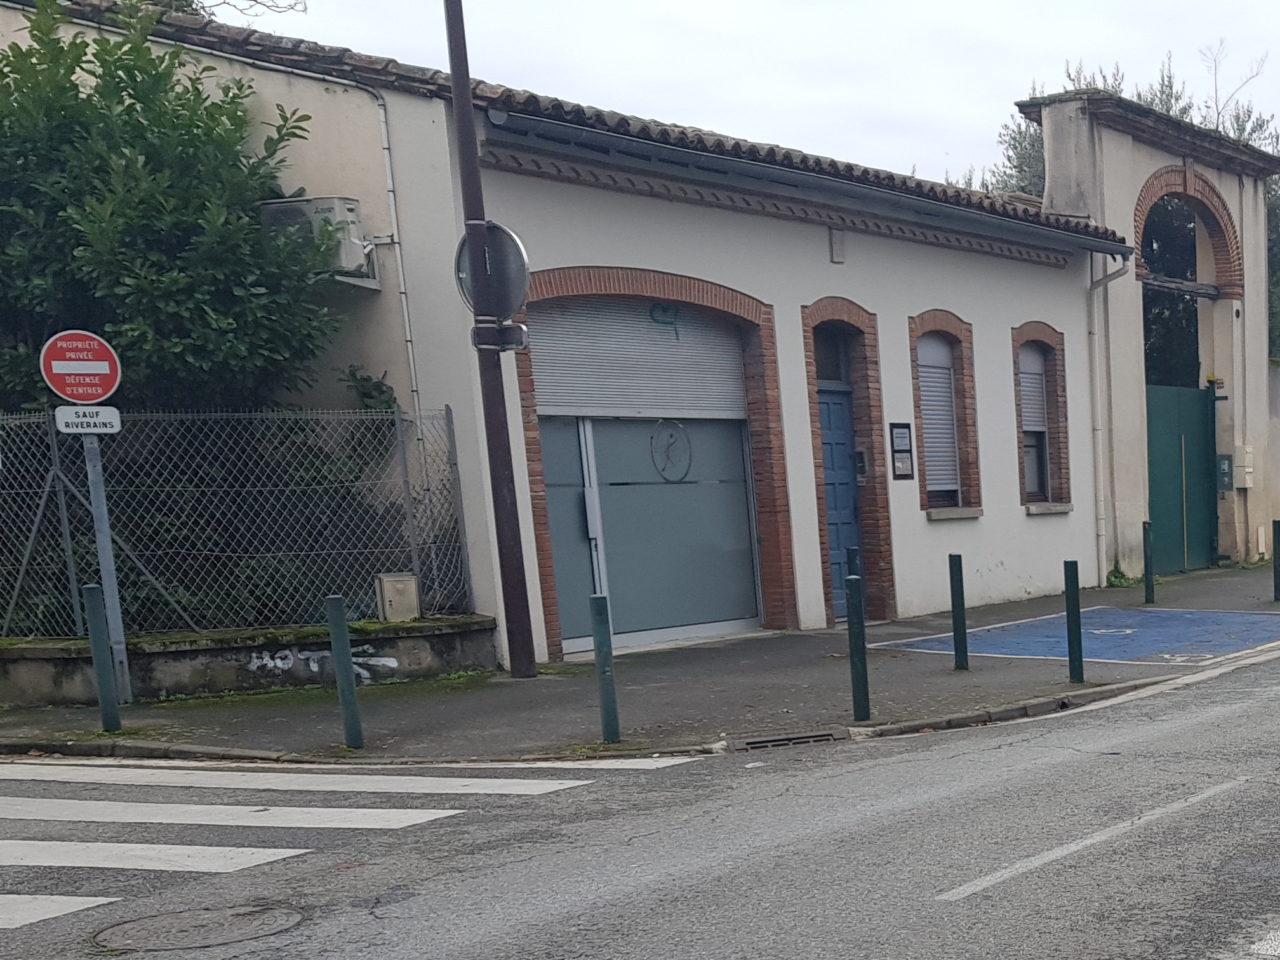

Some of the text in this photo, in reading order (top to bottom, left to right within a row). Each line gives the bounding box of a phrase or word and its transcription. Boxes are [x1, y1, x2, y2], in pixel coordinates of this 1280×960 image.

[57, 340, 99, 349] PROPRIÉTÉ
[66, 351, 93, 359] PRIVÉE
[65, 375, 100, 384] DÉFENSE
[66, 386, 103, 394] D'ENTRER
[74, 411, 101, 419] SAUF
[64, 421, 114, 430] RIVERAINS
